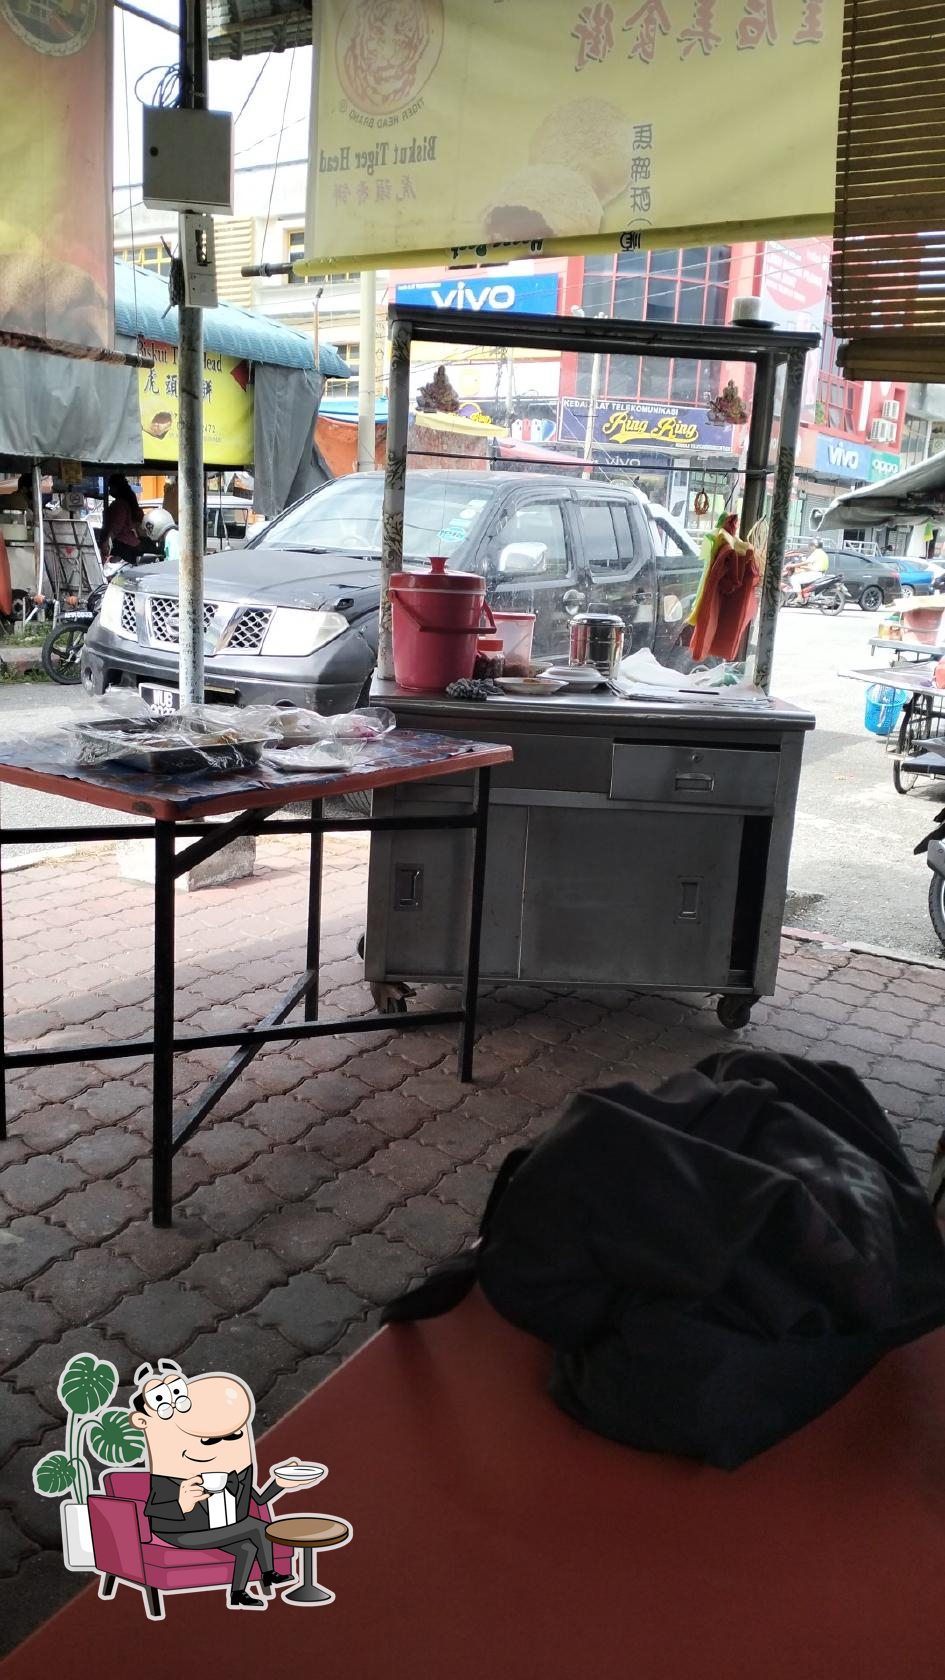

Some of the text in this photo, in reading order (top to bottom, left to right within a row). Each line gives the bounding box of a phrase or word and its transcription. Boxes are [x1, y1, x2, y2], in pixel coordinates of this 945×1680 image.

[432, 281, 516, 311] vivo
[611, 403, 679, 417] TELEKOMUNIKASI
[602, 410, 699, 440] Ring Ring
[827, 441, 859, 470] vivo
